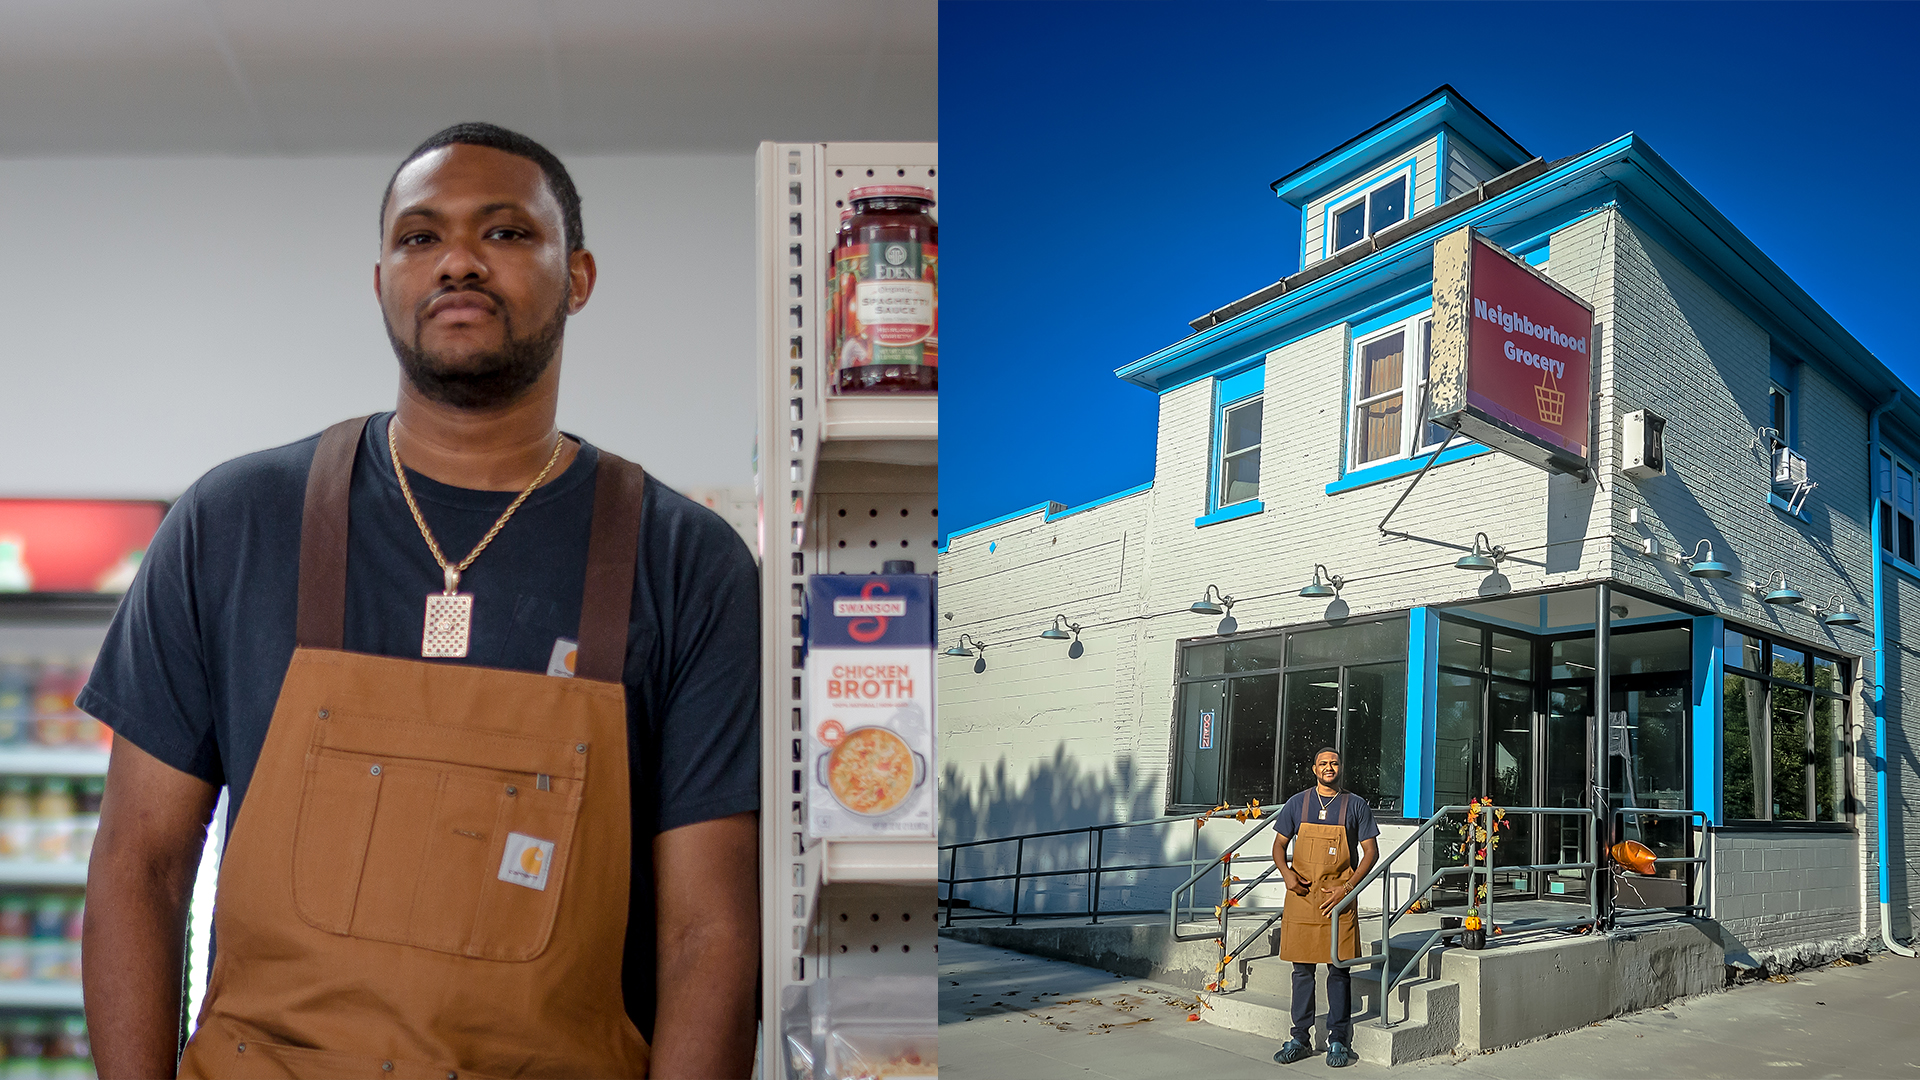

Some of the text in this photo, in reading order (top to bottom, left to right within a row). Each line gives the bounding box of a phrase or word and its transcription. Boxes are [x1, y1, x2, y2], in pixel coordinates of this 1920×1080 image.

[875, 264, 916, 280] EDEN
[862, 297, 930, 307] SPAGHETTI
[875, 306, 917, 315] SAUCE
[1474, 298, 1586, 354] Neighborhood
[1503, 340, 1565, 379] Grocery
[838, 602, 902, 614] SWANSON
[832, 665, 909, 679] CHICKEN
[827, 679, 914, 699] BROTH
[1202, 714, 1211, 747] OPEN
